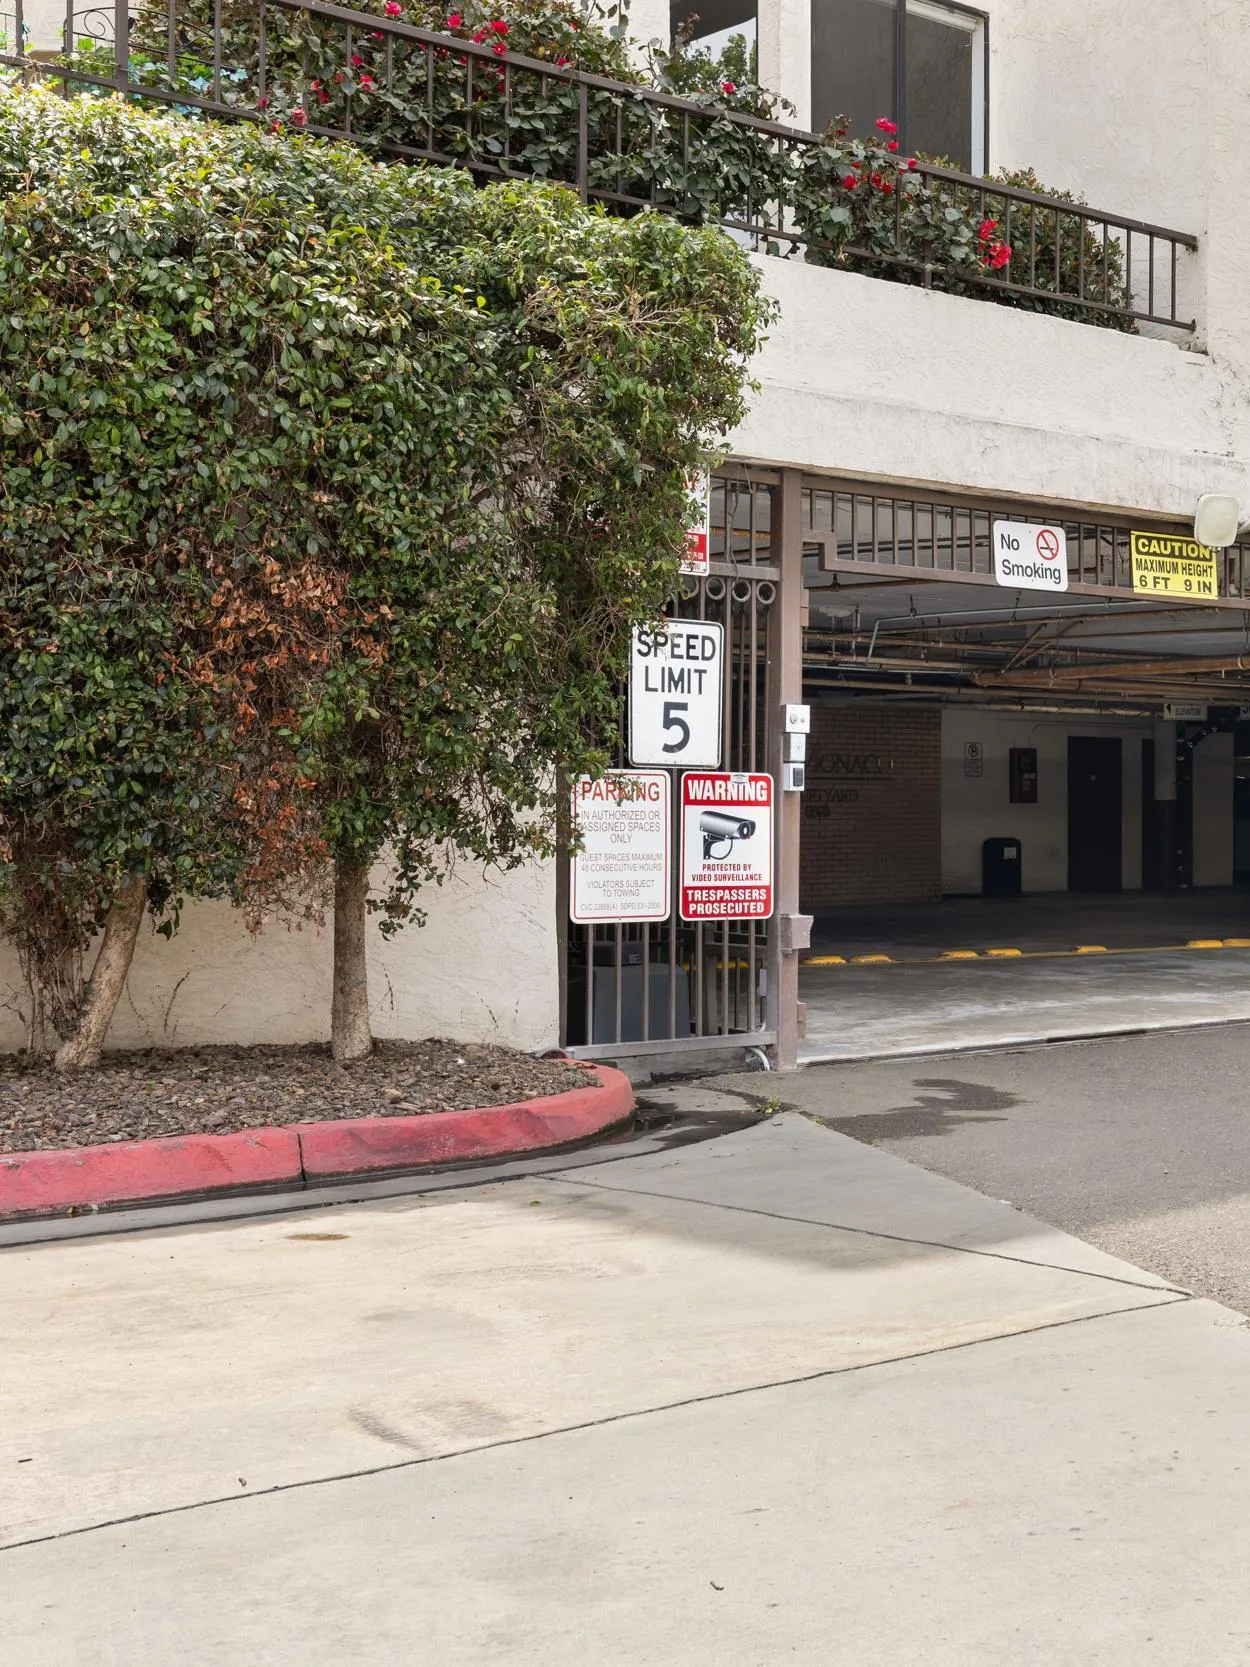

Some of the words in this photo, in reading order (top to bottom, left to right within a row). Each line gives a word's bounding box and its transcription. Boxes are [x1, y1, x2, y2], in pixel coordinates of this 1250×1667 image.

[1001, 533, 1020, 551] No
[1138, 538, 1210, 559] CAUTION
[1002, 559, 1061, 585] Smoking
[1136, 558, 1179, 575] MAXIMUM
[1181, 562, 1213, 578] HEIGHT
[1139, 574, 1148, 587] 6
[1153, 576, 1170, 589] FT
[1184, 579, 1192, 591] 9
[1197, 580, 1212, 593] IN
[637, 630, 716, 661] SPEED
[645, 665, 707, 695] LIMIT
[662, 701, 690, 753] 5
[687, 779, 768, 801] WARNING
[592, 810, 646, 821] AUTHORIZED
[648, 810, 661, 821] OR
[582, 821, 625, 832] ASSIGNED
[628, 821, 660, 832] SPACES
[610, 833, 632, 844] ONLY
[580, 853, 602, 862] GUEST
[604, 853, 630, 861] SPACES
[632, 852, 662, 861] MAXIMUM
[581, 863, 589, 872] 48
[591, 863, 637, 872] CONSECUTIVE
[639, 862, 662, 871] HOURS
[702, 863, 741, 871] PROTECTED
[743, 863, 752, 871] BY
[691, 873, 712, 881] VIDEO
[714, 873, 762, 881] SURVEILLANCE
[587, 880, 624, 889] VIOLATORS
[625, 879, 655, 888] SUBJECT
[602, 889, 612, 897] TO
[614, 888, 640, 897] TOWING
[687, 888, 767, 901] TRESPASSERS
[580, 903, 593, 911] CVC
[689, 901, 764, 915] PROSECUTED
